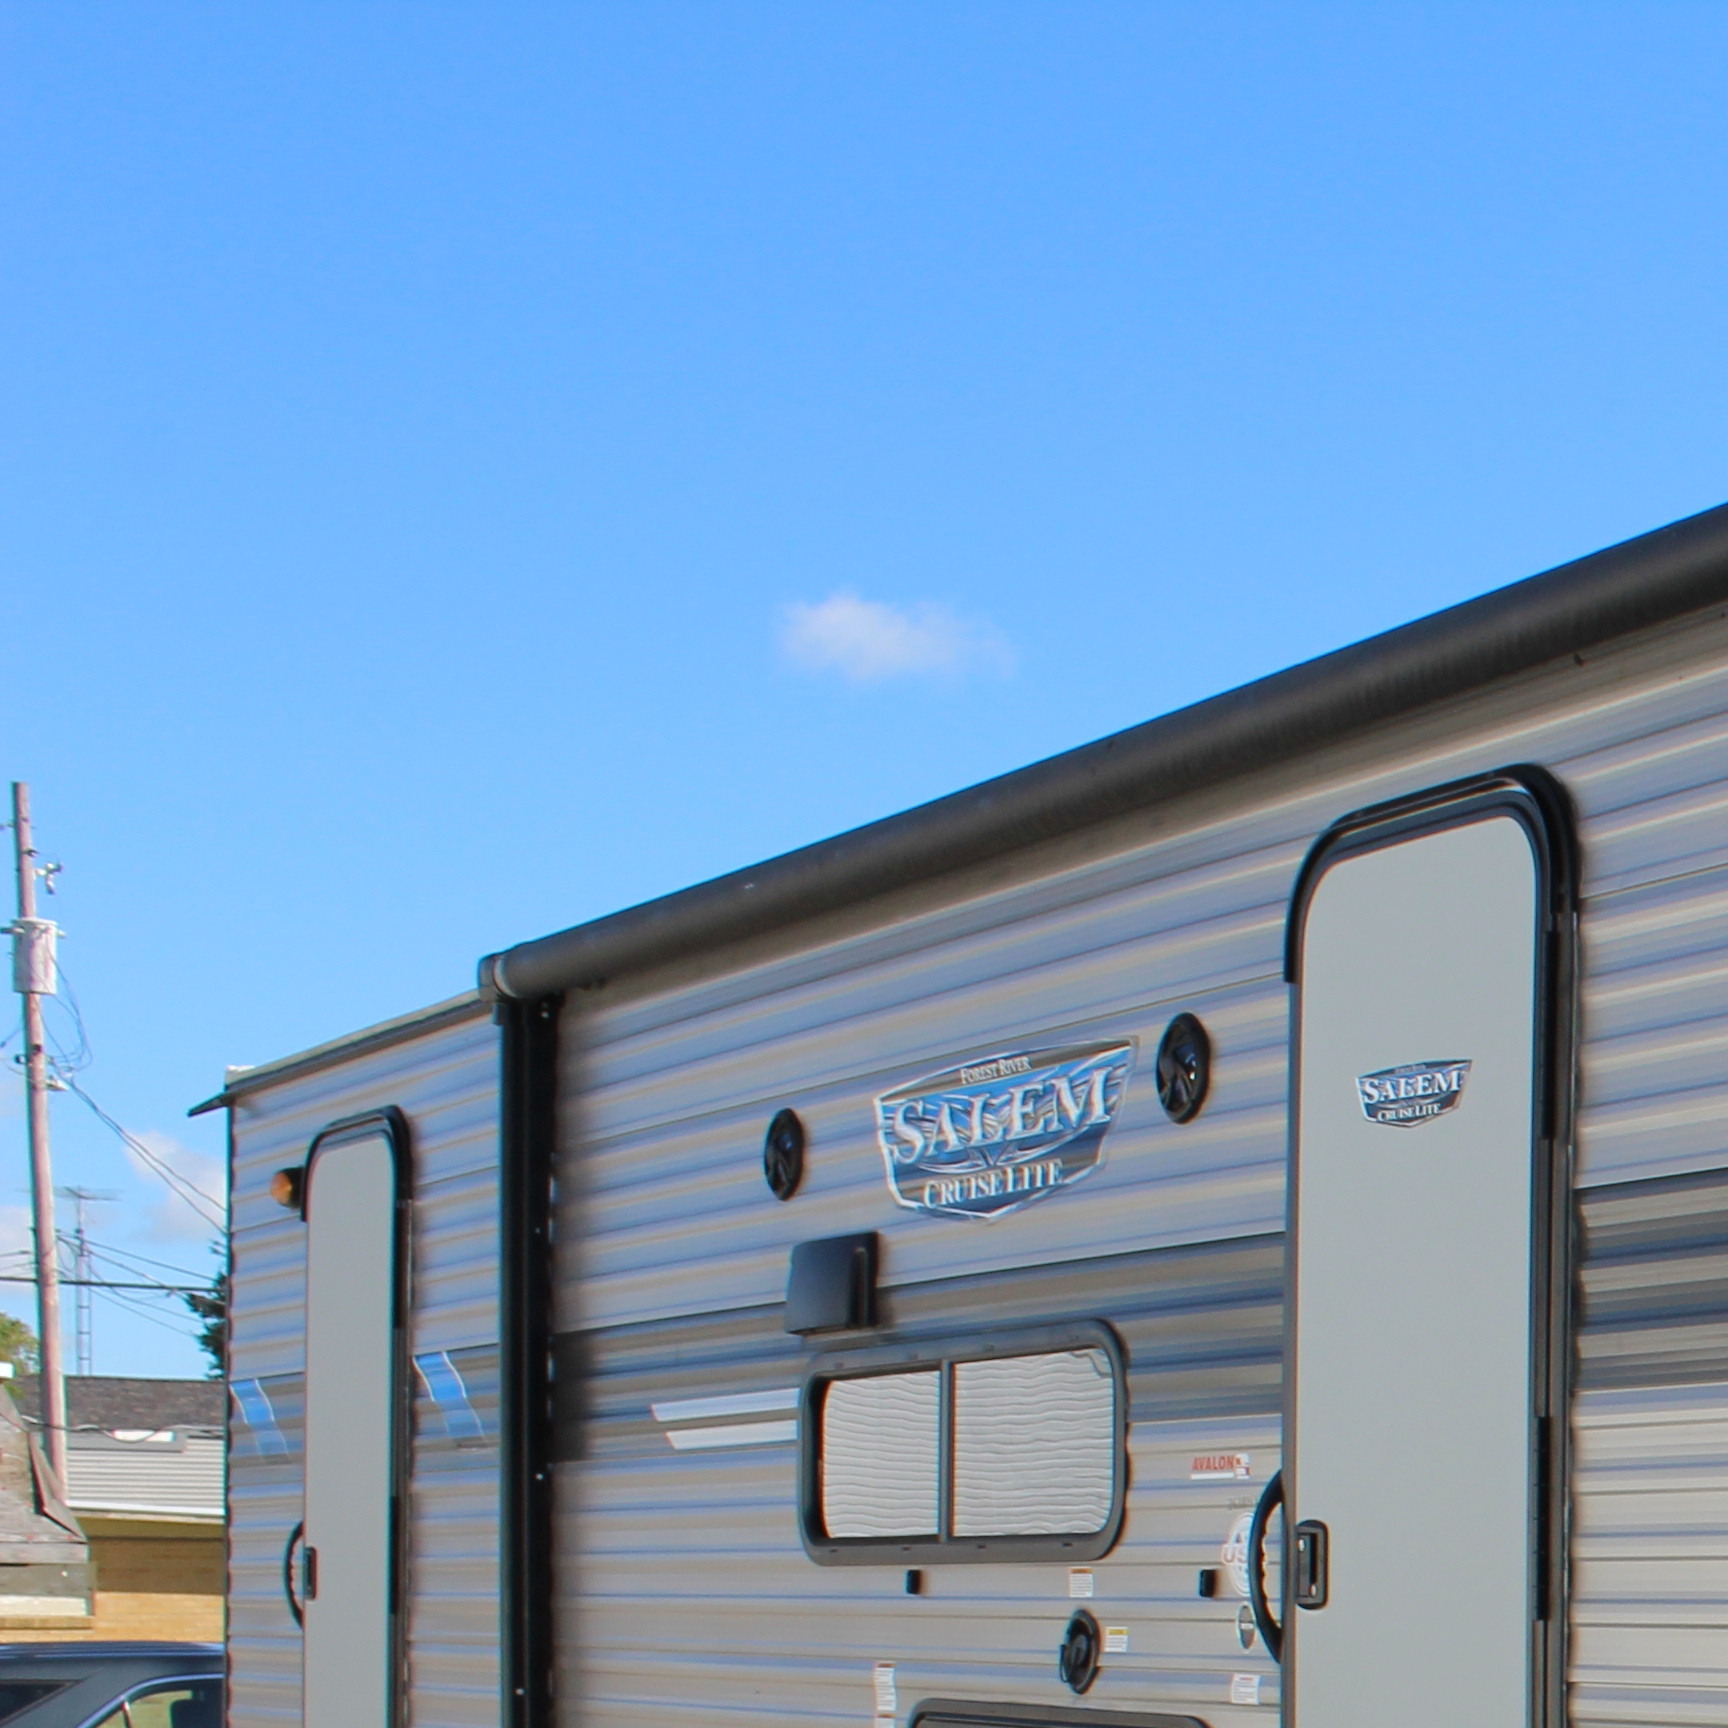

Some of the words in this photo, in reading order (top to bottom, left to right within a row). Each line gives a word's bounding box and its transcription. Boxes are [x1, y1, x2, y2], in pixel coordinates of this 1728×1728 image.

[960, 1061, 999, 1085] FOREST
[999, 1056, 1032, 1077] RIVER
[1363, 1070, 1461, 1103] SALEM
[892, 1066, 1113, 1165] SALEM
[1192, 1455, 1235, 1471] AVALON
